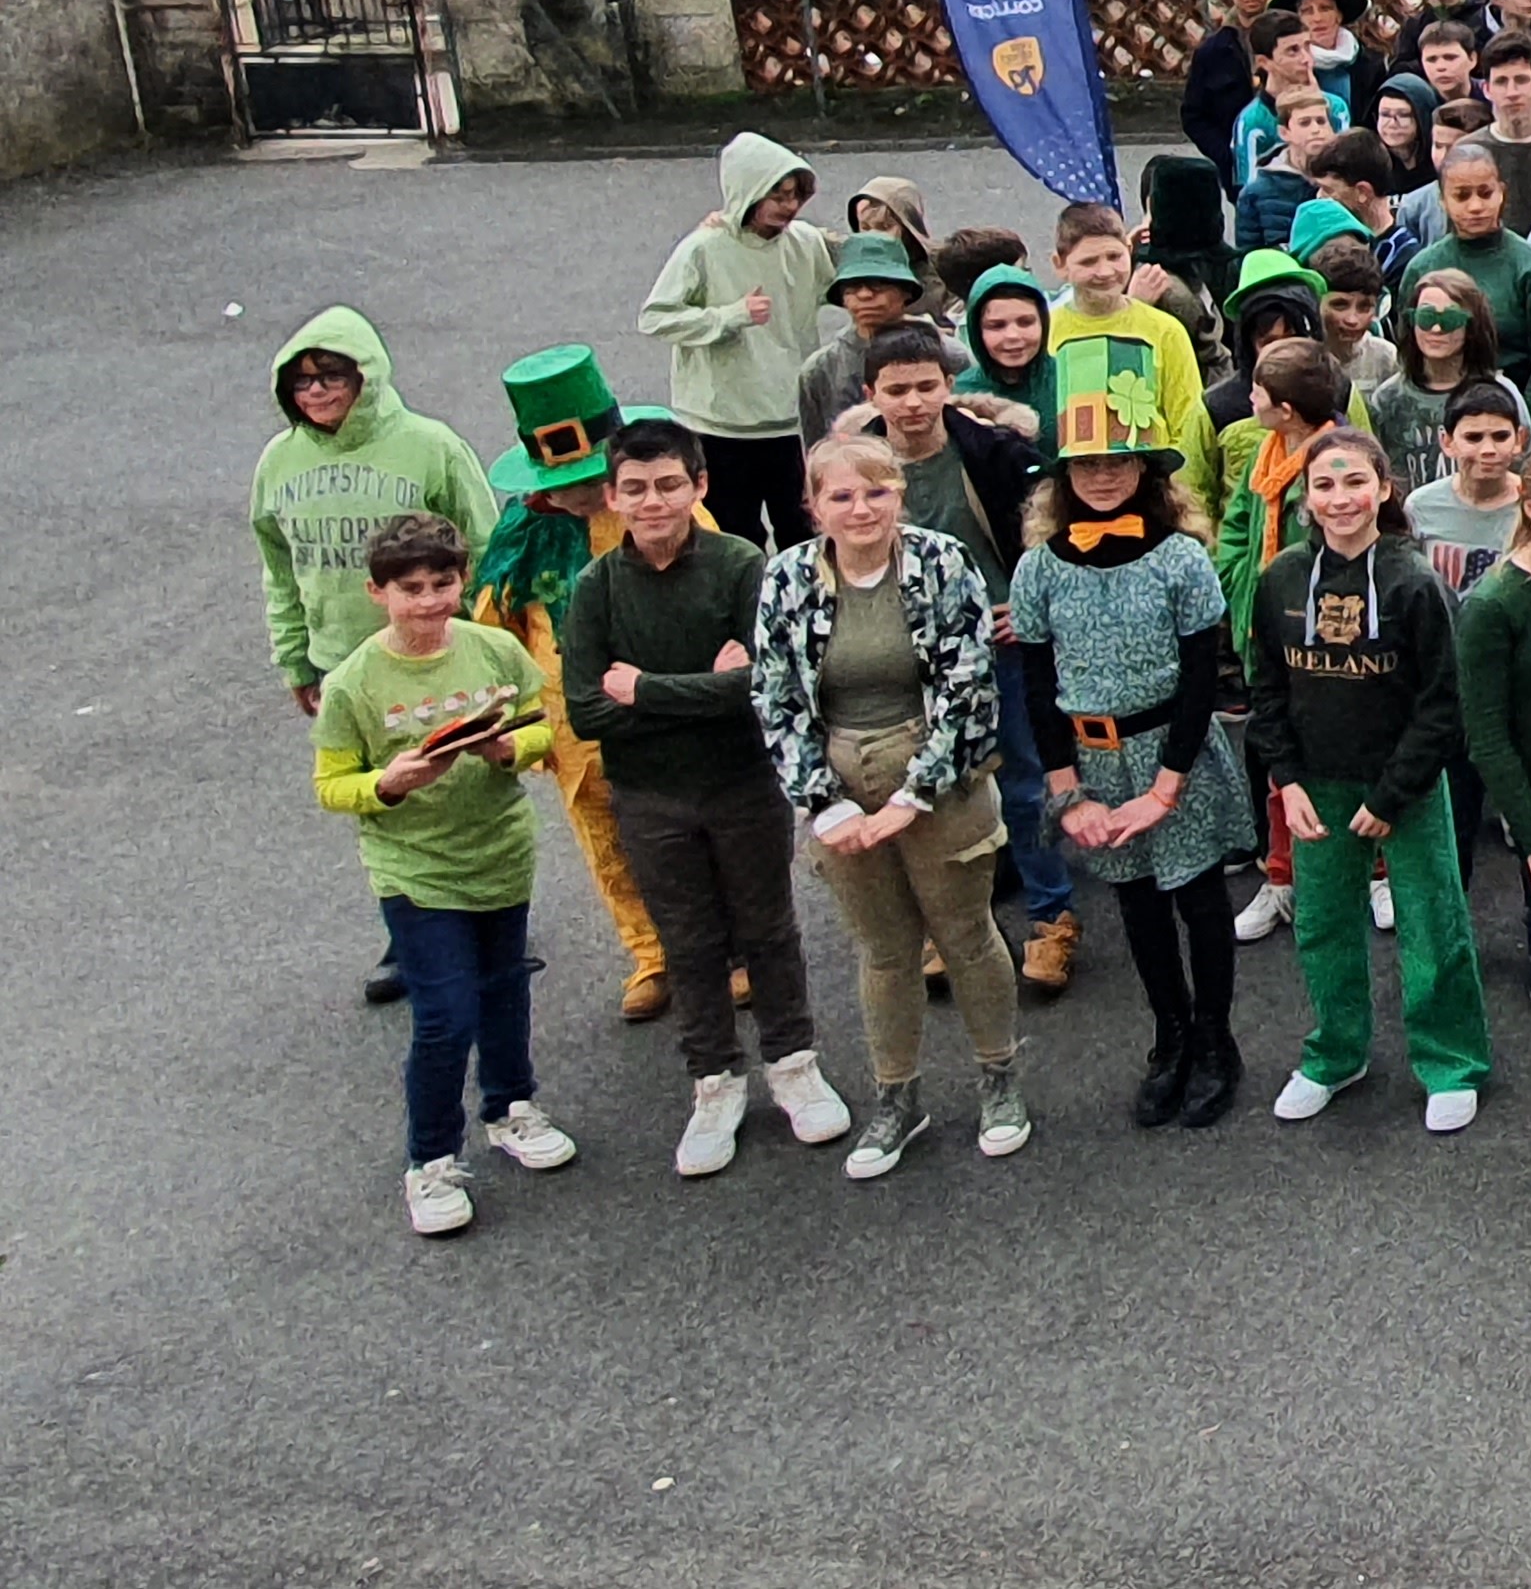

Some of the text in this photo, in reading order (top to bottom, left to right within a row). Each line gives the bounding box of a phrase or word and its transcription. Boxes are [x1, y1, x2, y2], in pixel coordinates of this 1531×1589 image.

[273, 463, 420, 513] UNIVERSITY OF
[1284, 645, 1399, 675] IRELAND
